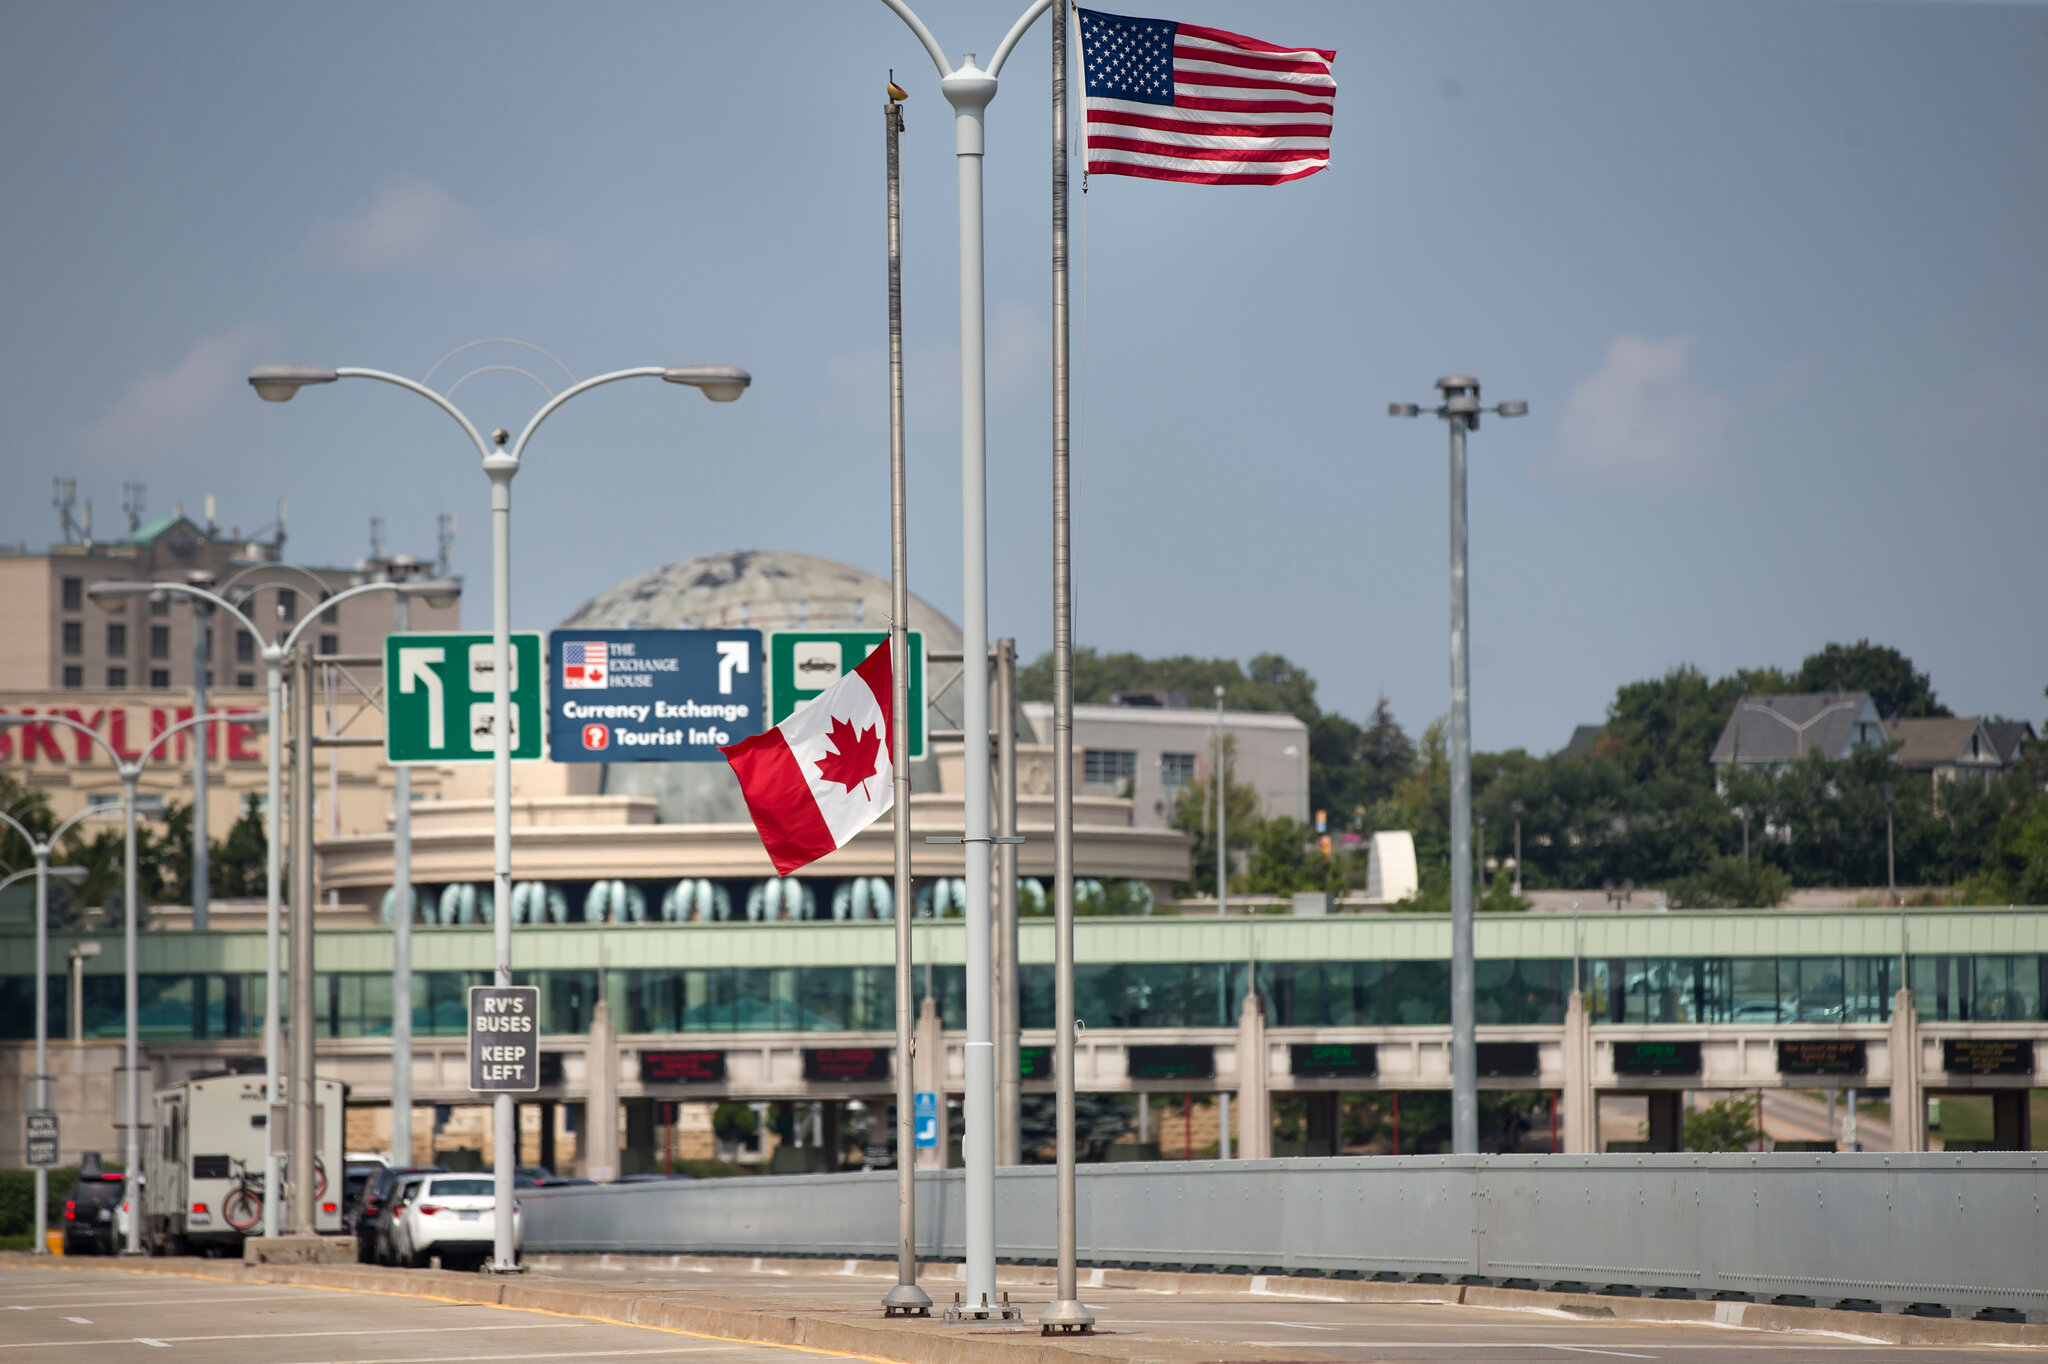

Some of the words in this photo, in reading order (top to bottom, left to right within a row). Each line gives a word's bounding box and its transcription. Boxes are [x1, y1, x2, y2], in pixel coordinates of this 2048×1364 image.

[609, 643, 636, 656] THE
[609, 658, 679, 671] EXCHANGE
[609, 674, 653, 687] HOUSE
[562, 700, 650, 723] Currency
[654, 698, 749, 723] Exchange
[614, 726, 684, 746] Tourist
[688, 726, 730, 746] Info
[484, 997, 524, 1014] RV'S
[476, 1016, 532, 1033] BUSES
[481, 1045, 526, 1062] KEEP
[482, 1064, 525, 1081] LEFT
